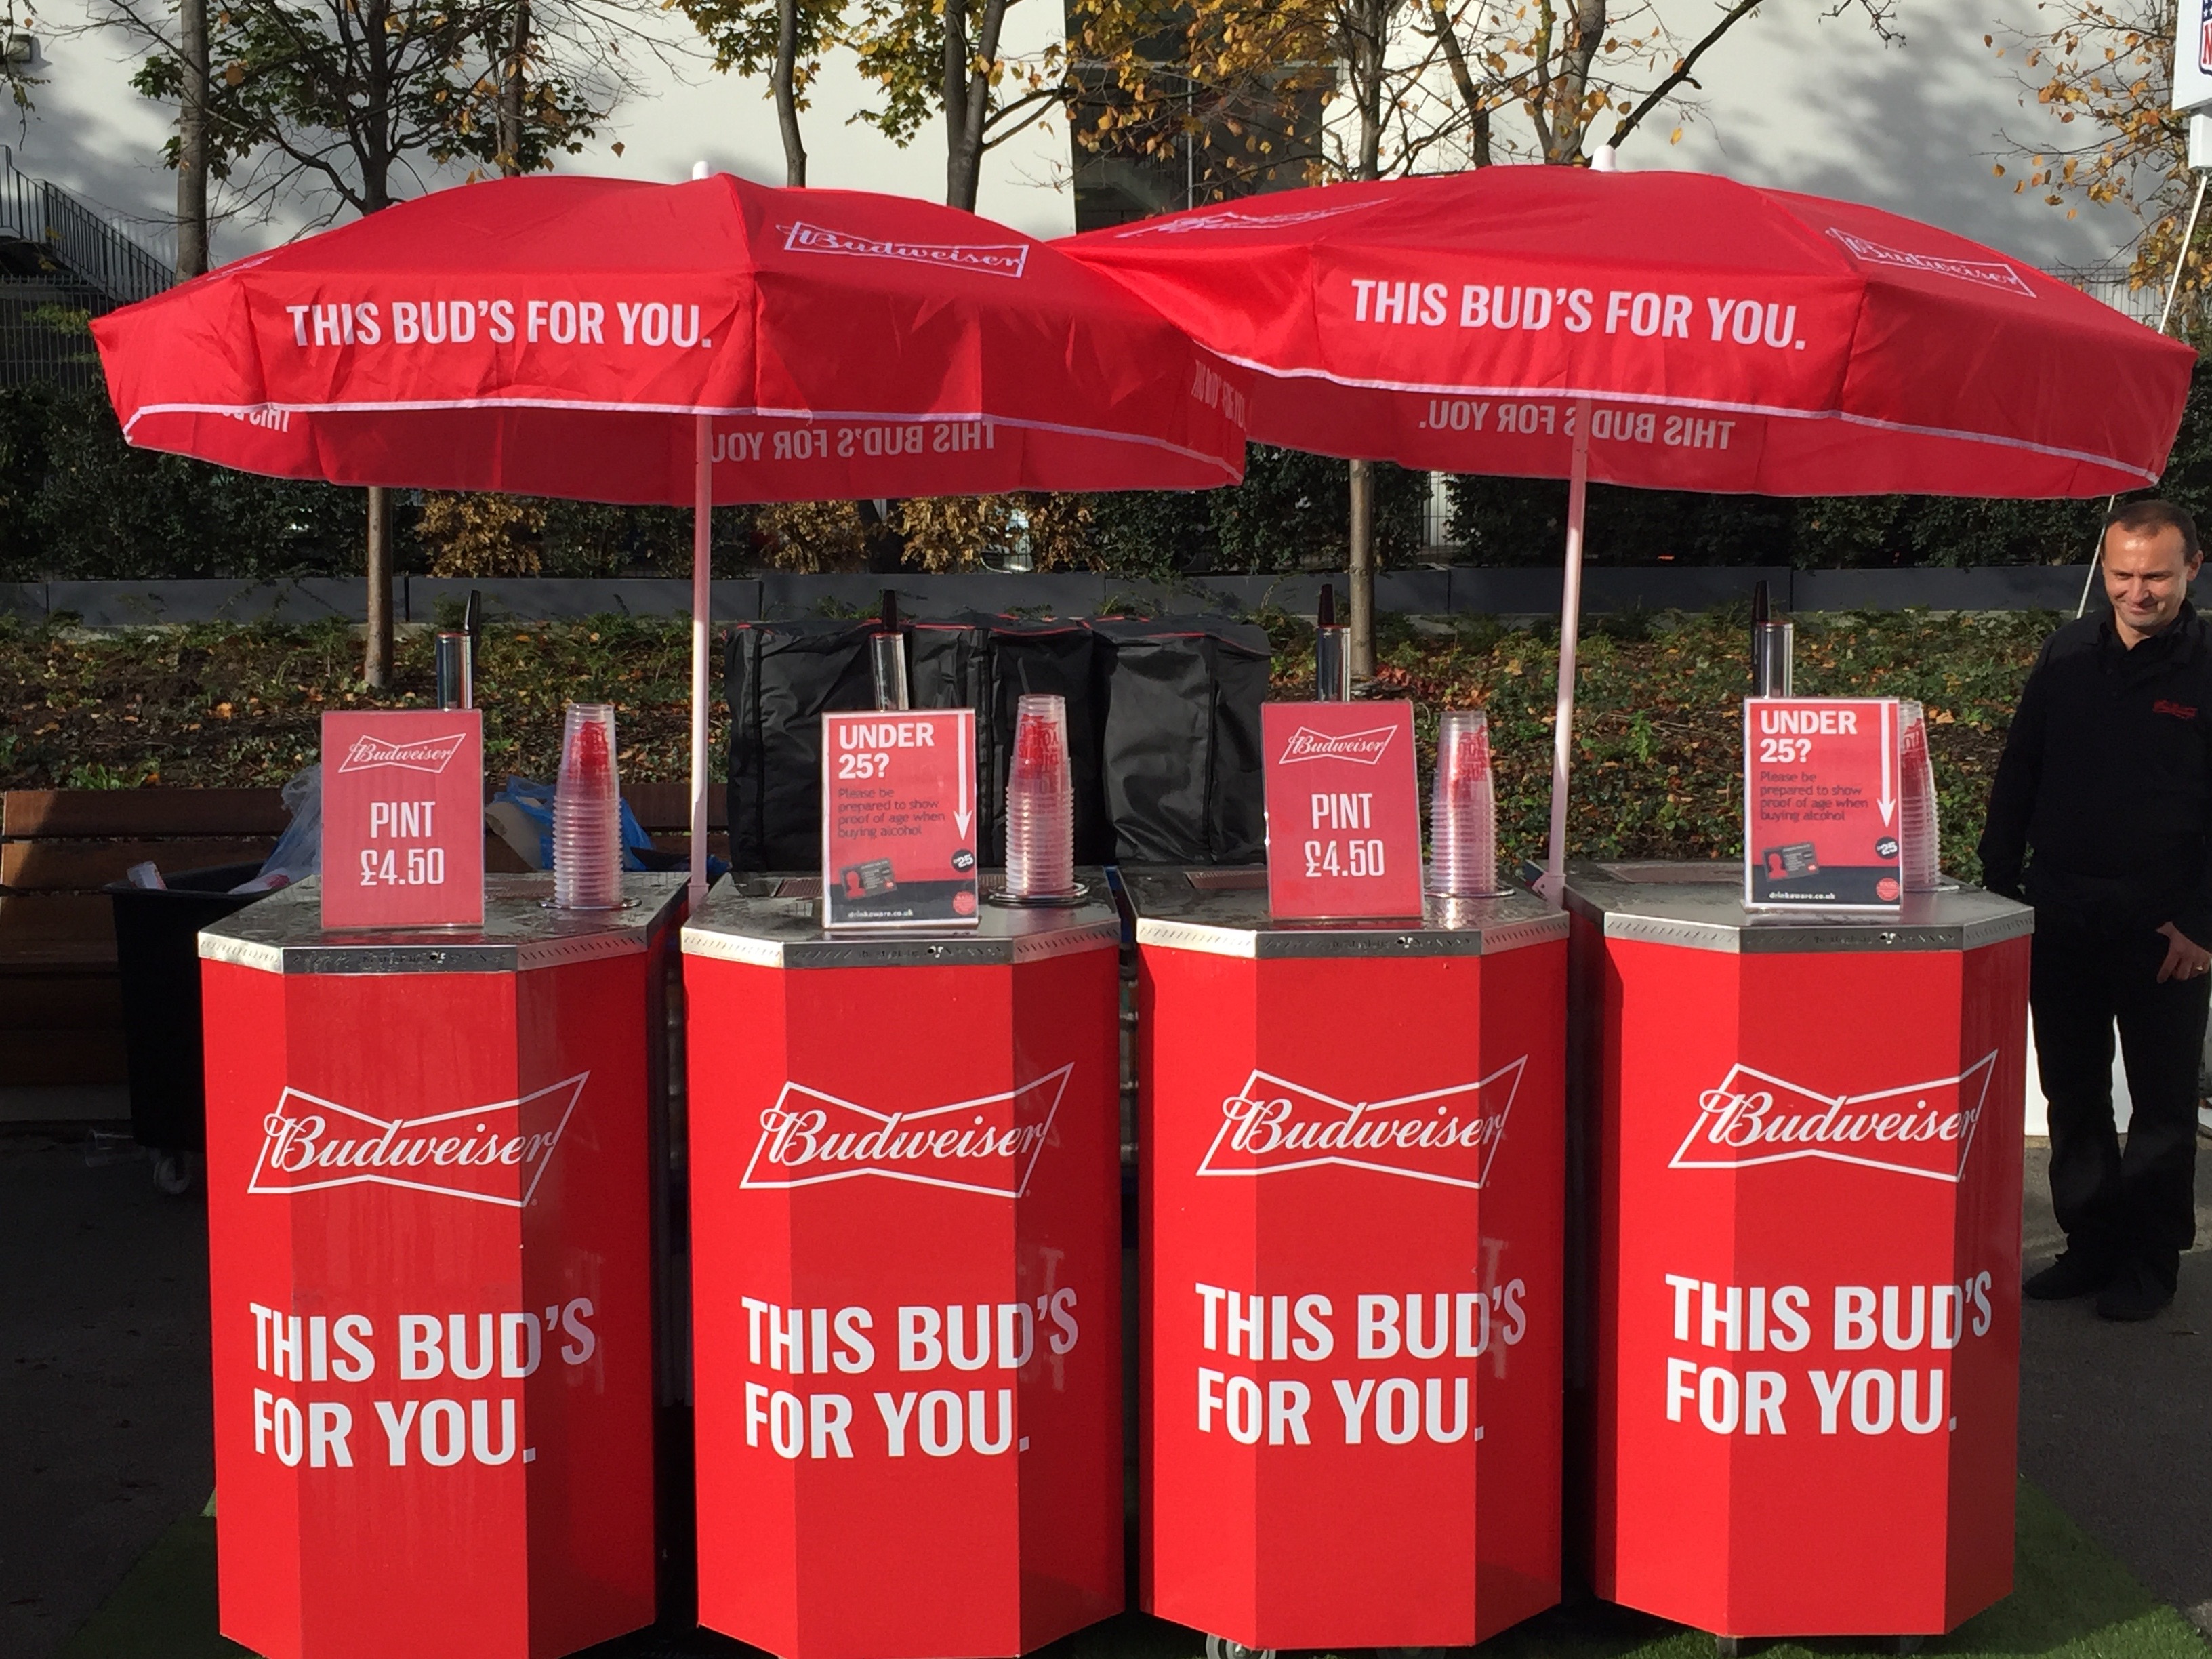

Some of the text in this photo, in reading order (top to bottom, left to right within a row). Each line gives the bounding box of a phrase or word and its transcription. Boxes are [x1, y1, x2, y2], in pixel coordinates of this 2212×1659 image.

[775, 224, 1025, 268] Budweiser
[285, 300, 712, 348] THIS BUD'S FOR YOU.
[1351, 279, 1806, 350] THIS BUD'S FOR YOU.
[839, 722, 935, 750] UNDER
[1761, 710, 1858, 735] UNDER
[349, 743, 453, 762] Budweiser
[1288, 735, 1387, 754] Budweiser
[1760, 738, 1811, 763] 25?
[838, 752, 890, 779] 25?
[1760, 771, 1816, 782] Please be
[838, 787, 894, 799] Please be
[838, 799, 939, 813] prepared to show
[1760, 785, 1861, 798] prepared to show
[1760, 798, 1868, 811] proof of age when
[370, 801, 436, 838] PINT
[838, 811, 945, 826] proof of age when
[1311, 793, 1372, 830] PINT
[1760, 810, 1845, 823] buying alcohol
[838, 825, 922, 840] buying alcohol
[360, 848, 445, 886] £4.50
[1305, 840, 1385, 877] £4.50
[848, 908, 913, 918] drinkaware.co.uk
[1769, 891, 1835, 900] drinkaware.co.uk
[1222, 1096, 1503, 1154] Budweiser
[1698, 1089, 1978, 1147] Budweiser
[264, 1113, 554, 1172] Budweiser
[760, 1108, 1046, 1166] Budweiser
[1195, 1278, 1526, 1361] THIS BUD'S
[1665, 1270, 1992, 1351] THIS BUD'S
[250, 1298, 596, 1382] THIS BUD'S
[741, 1287, 1078, 1374] THIS BUD'S
[1198, 1367, 1483, 1446] FOR YOU.
[1666, 1357, 1957, 1435] FOR YOU.
[254, 1387, 536, 1467] FOR YOU.
[745, 1380, 1029, 1459] FOR YOU.
